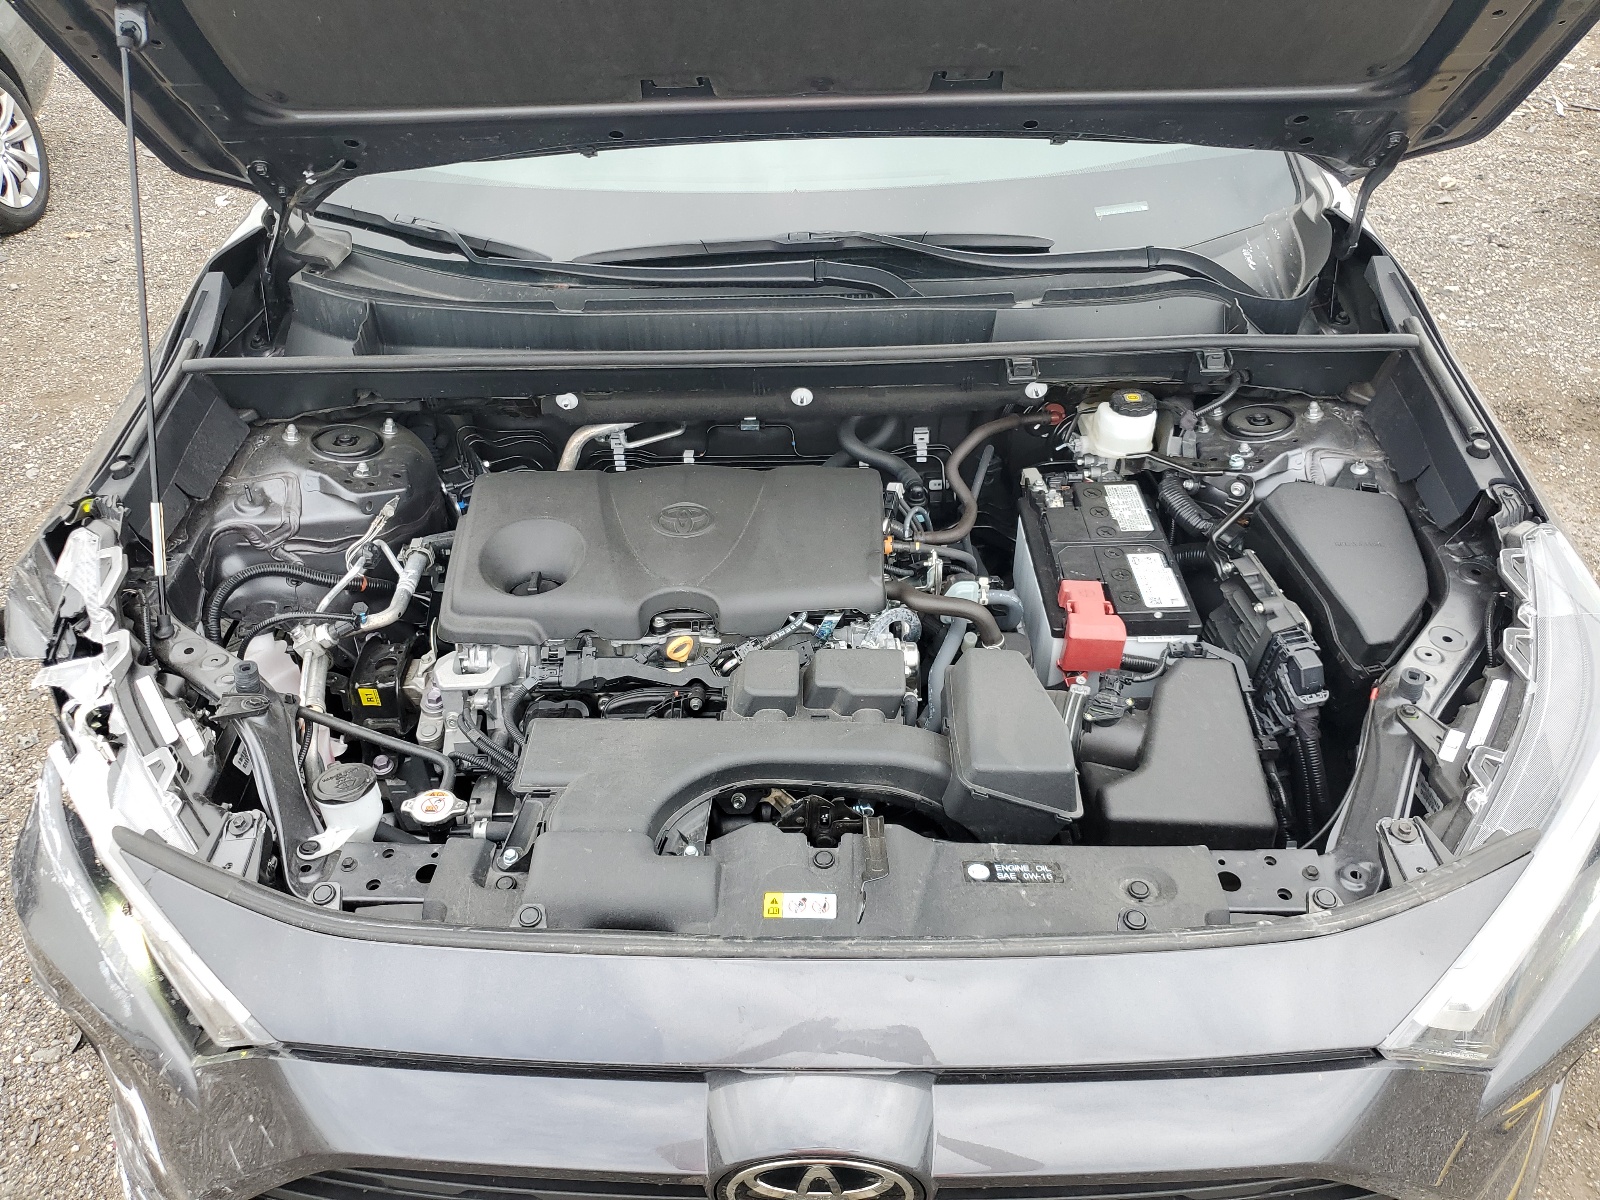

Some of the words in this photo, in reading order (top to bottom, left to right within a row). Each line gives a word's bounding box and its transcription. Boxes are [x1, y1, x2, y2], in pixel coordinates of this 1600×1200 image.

[994, 864, 1030, 872] ENGINE
[996, 872, 1017, 880] SAE
[1022, 872, 1053, 880] 0W-16
